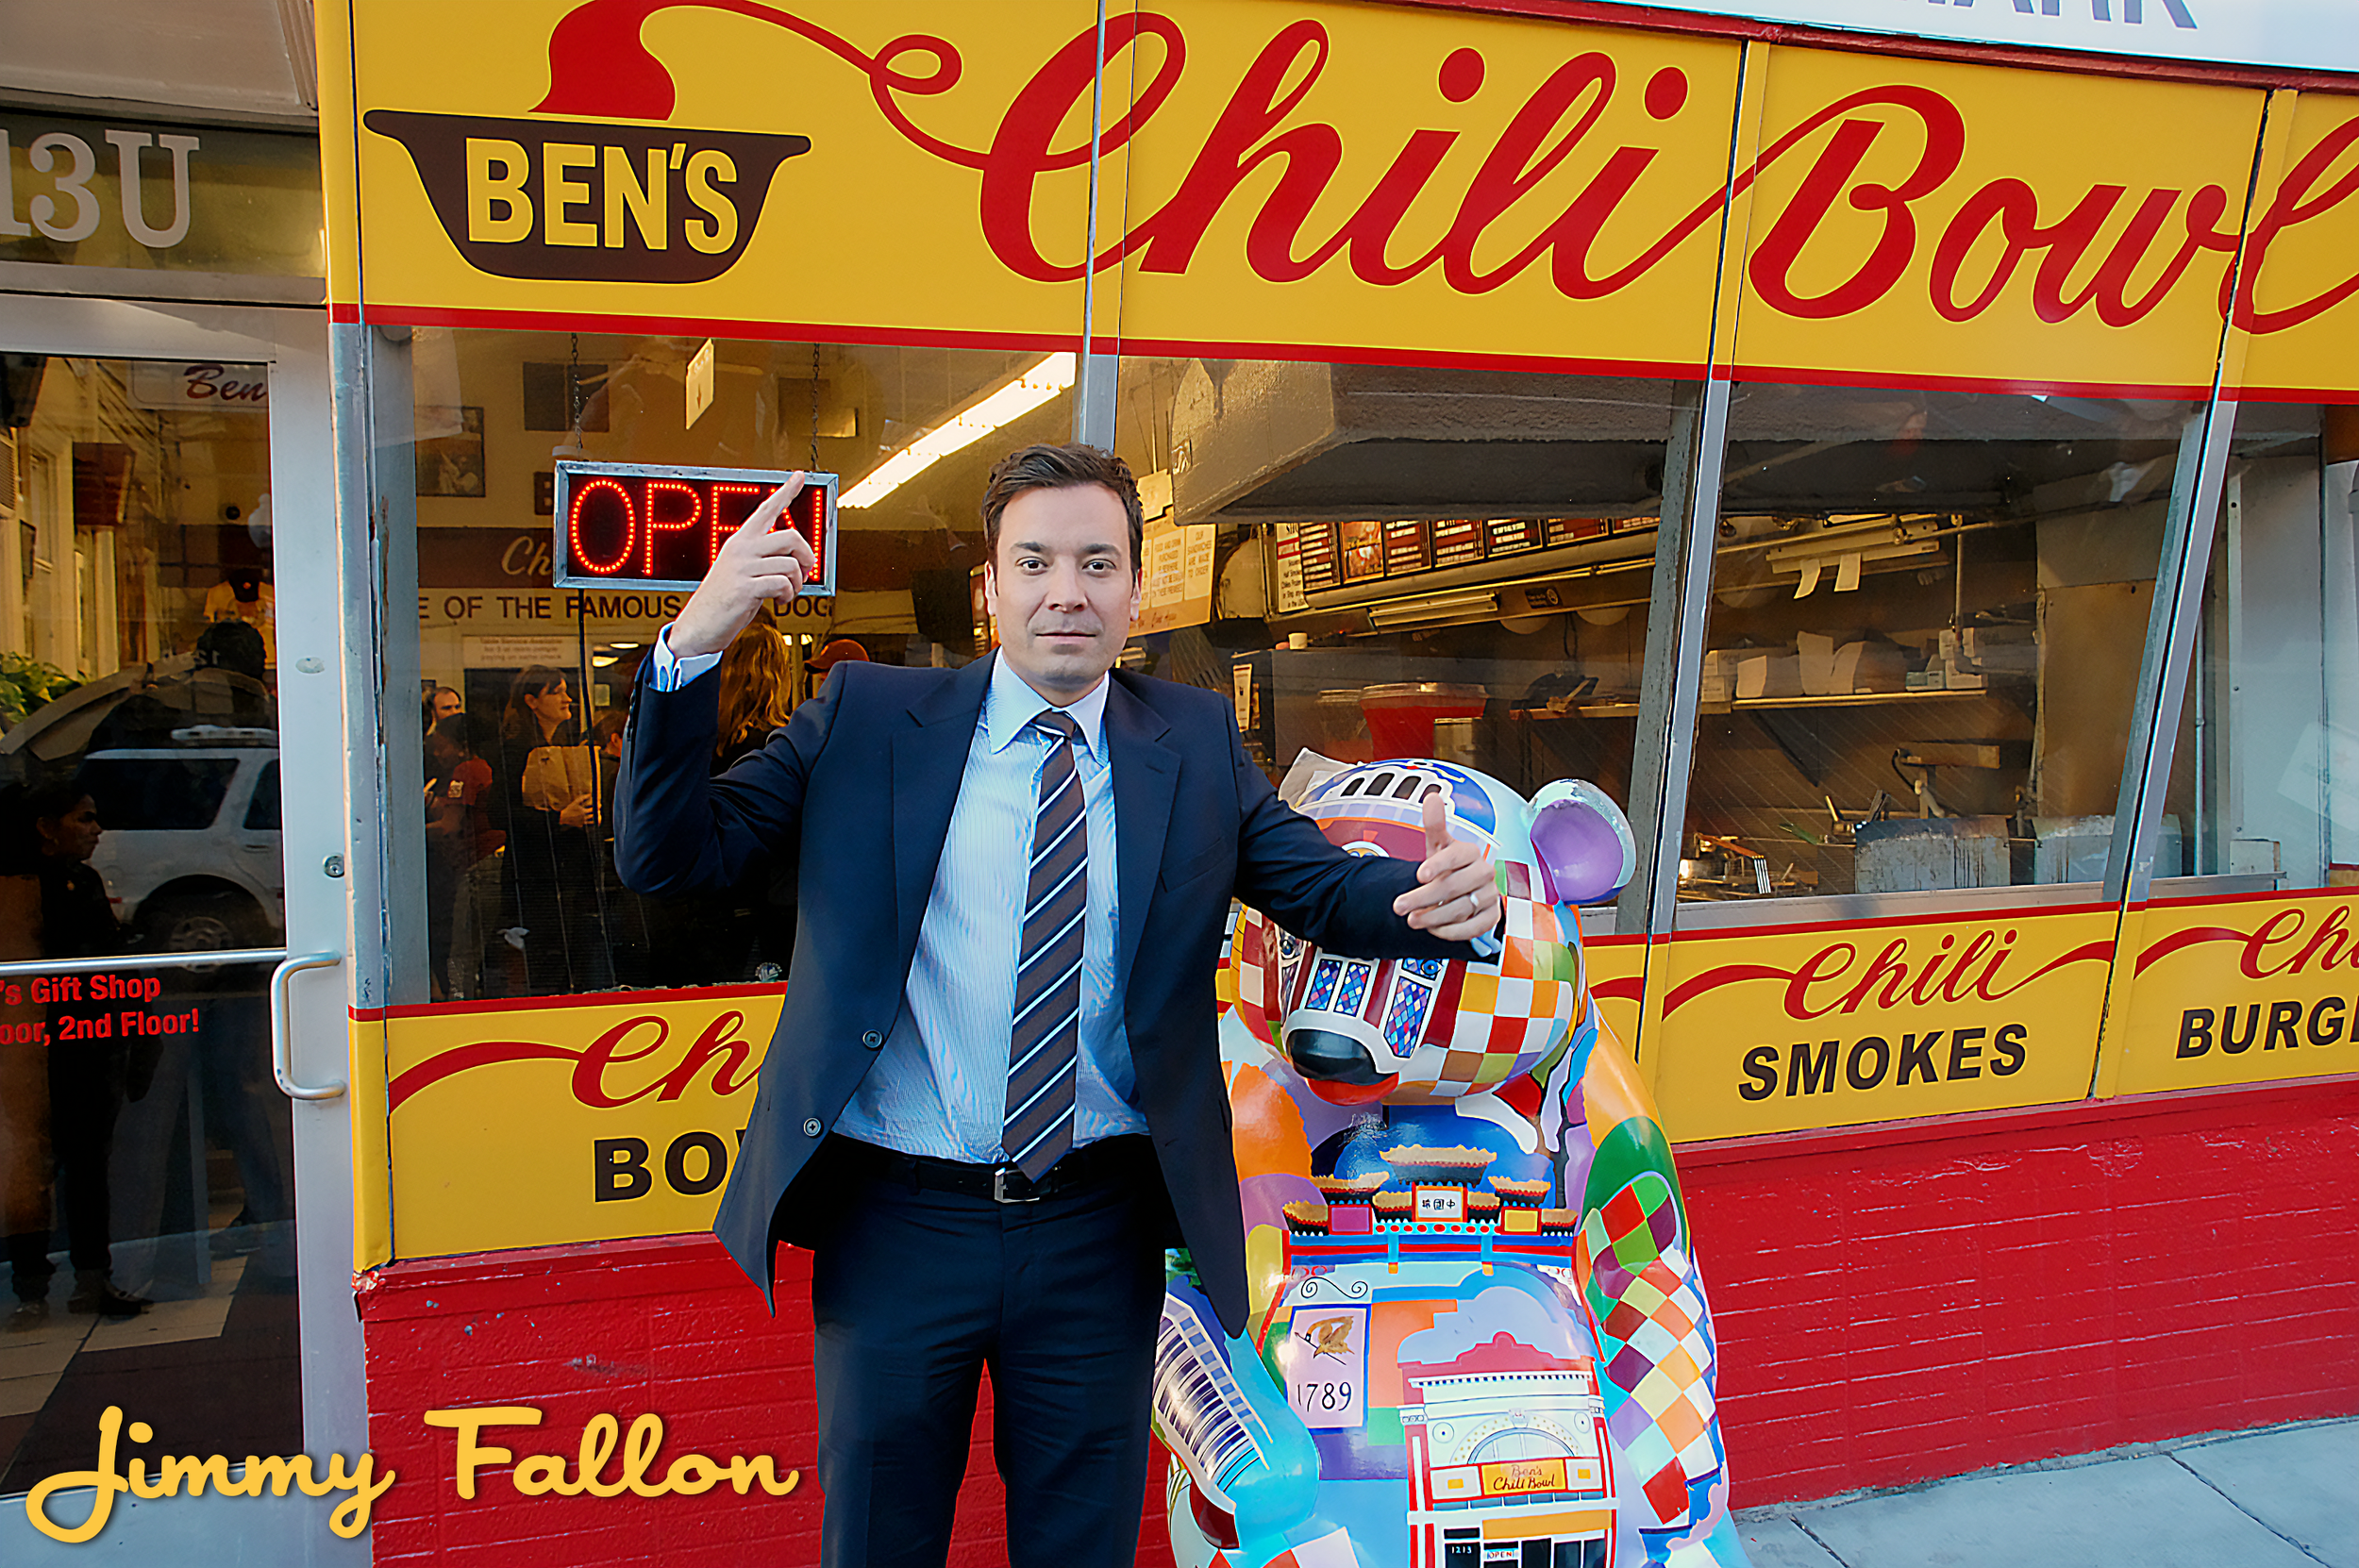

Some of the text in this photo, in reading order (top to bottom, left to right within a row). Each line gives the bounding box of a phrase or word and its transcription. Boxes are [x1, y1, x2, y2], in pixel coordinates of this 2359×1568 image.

[979, 11, 2359, 335] Chili Bowl
[464, 137, 740, 255] BEN'S
[443, 596, 483, 620] OF
[496, 596, 551, 620] THE
[566, 594, 681, 619] FAMOUS
[31, 976, 83, 1003] Gift
[90, 975, 161, 1002] Shop
[1782, 927, 2025, 1021] Chili
[58, 1012, 112, 1042] 2nd
[121, 1008, 200, 1038] Floor!
[2176, 995, 2359, 1059] BURG
[1737, 1024, 2029, 1102] SMOKES
[594, 1128, 746, 1203] BO
[1297, 1381, 1352, 1412] 1789
[1511, 1463, 1543, 1477] Ben's
[1528, 1473, 1555, 1489] Bowl
[1451, 1545, 1472, 1555] 1213
[1488, 1551, 1513, 1560] OPEN
